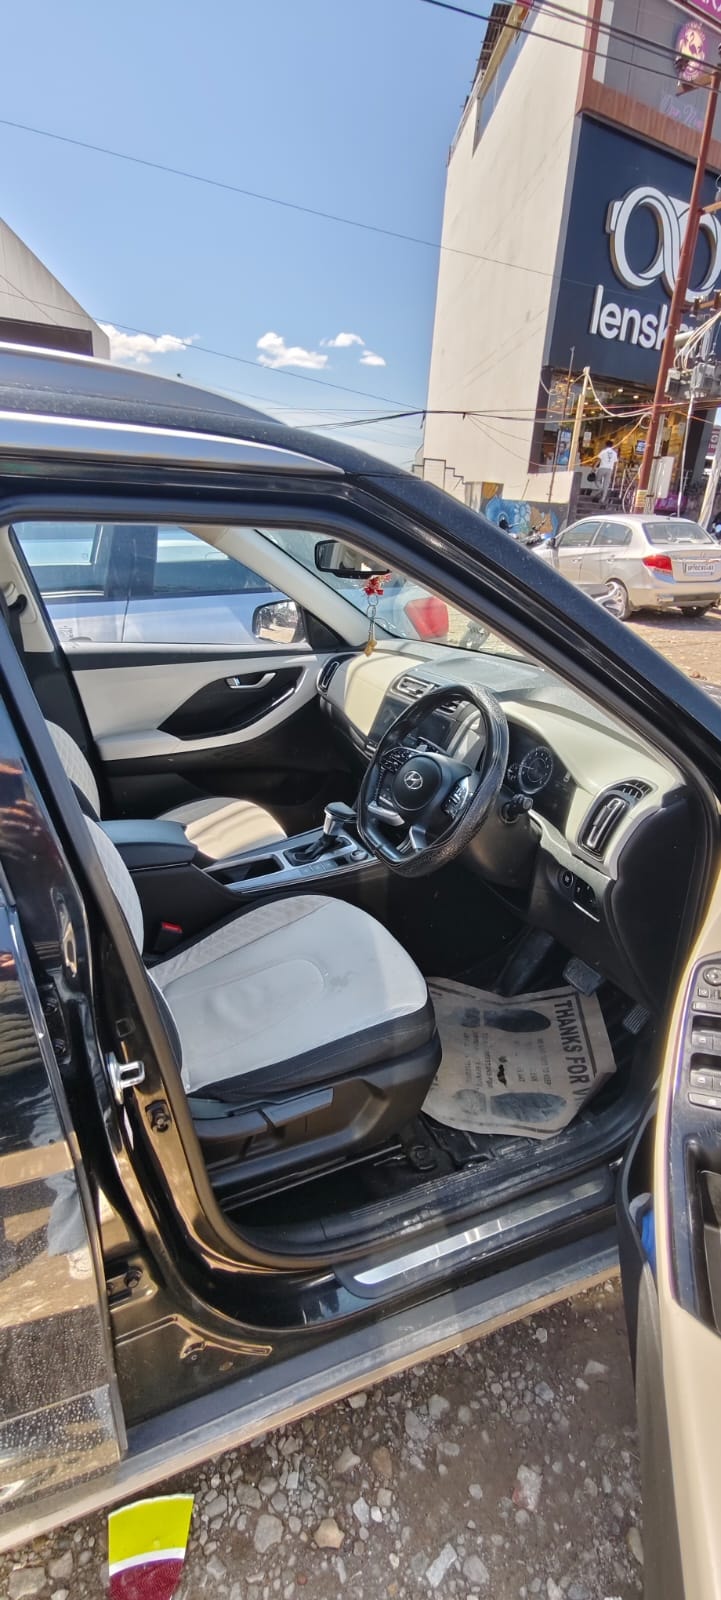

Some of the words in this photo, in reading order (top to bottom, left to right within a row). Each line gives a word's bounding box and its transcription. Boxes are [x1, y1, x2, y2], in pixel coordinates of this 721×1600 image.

[589, 284, 700, 355] lensk
[554, 999, 583, 1053] THANKS
[565, 1056, 591, 1084] FOR
